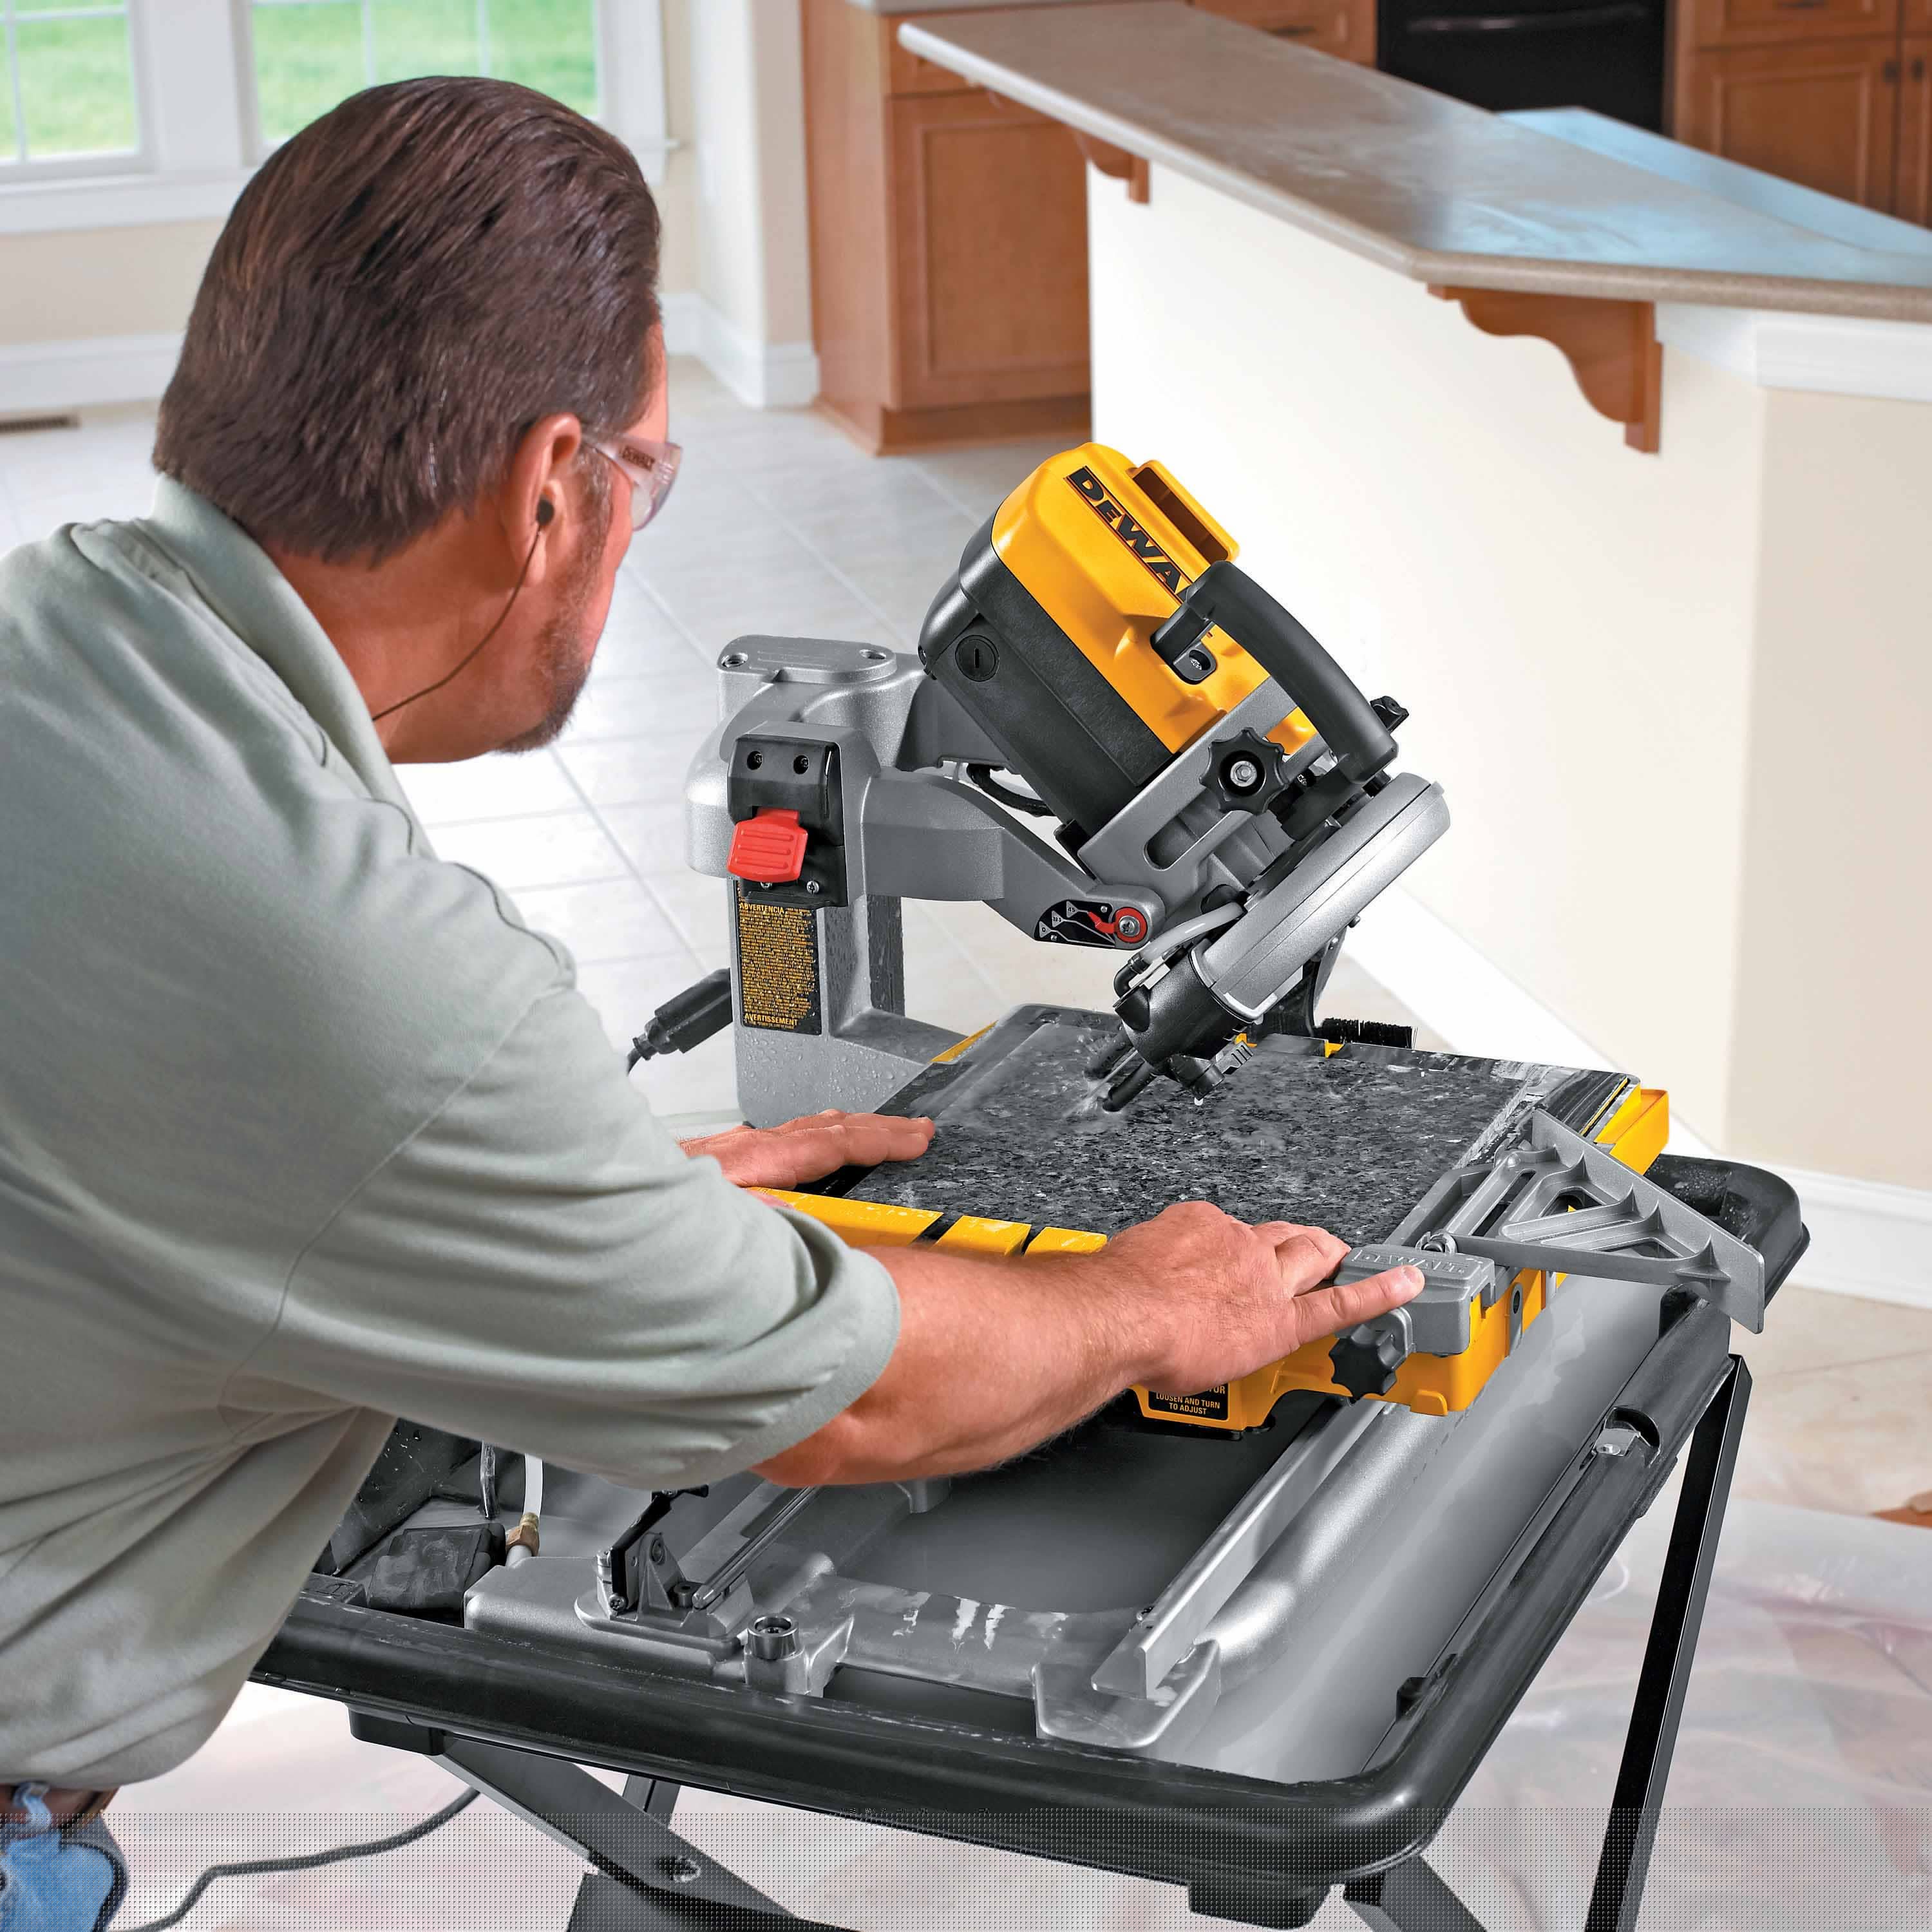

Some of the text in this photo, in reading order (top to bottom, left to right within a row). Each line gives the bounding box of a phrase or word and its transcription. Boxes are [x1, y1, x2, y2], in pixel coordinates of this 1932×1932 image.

[1066, 466, 1189, 602] DEWA
[739, 902, 785, 914] ADVERTENCIA
[744, 1013, 799, 1026] AVERTISSEMENT
[1155, 1392, 1220, 1409] LOOSEN AND TURN
[1169, 1402, 1208, 1415] TO ADJUST
